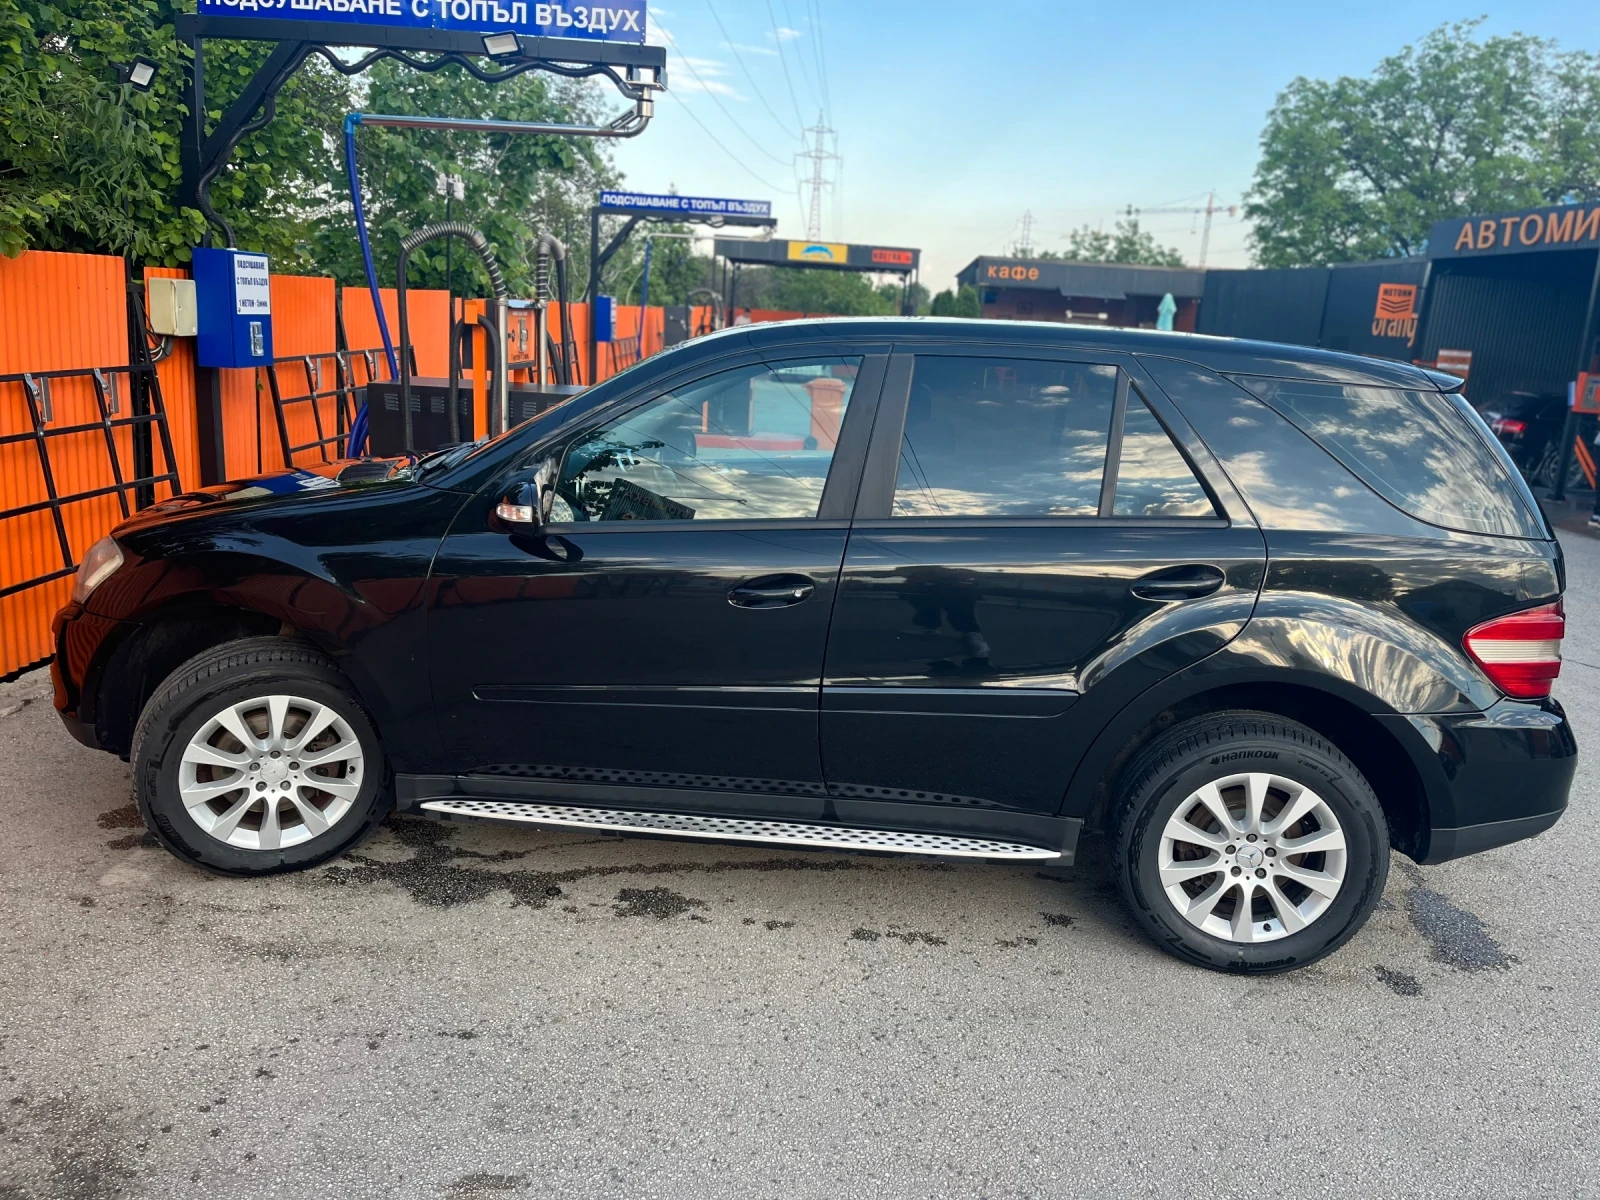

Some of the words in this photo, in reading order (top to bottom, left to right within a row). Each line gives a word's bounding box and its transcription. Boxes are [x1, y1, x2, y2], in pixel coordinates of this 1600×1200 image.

[411, 0, 429, 17] С
[436, 0, 527, 24] ТОПЪЛ
[535, 4, 640, 33] ВЪЗДУХ
[602, 194, 679, 208] ПОДСУШАВАНЕ
[681, 200, 690, 209] С
[691, 201, 726, 211] ТОПЪЛ
[728, 203, 769, 214] ВЪЗДУХ
[1454, 207, 1600, 250] АВТОМИ
[988, 265, 1039, 280] кафе
